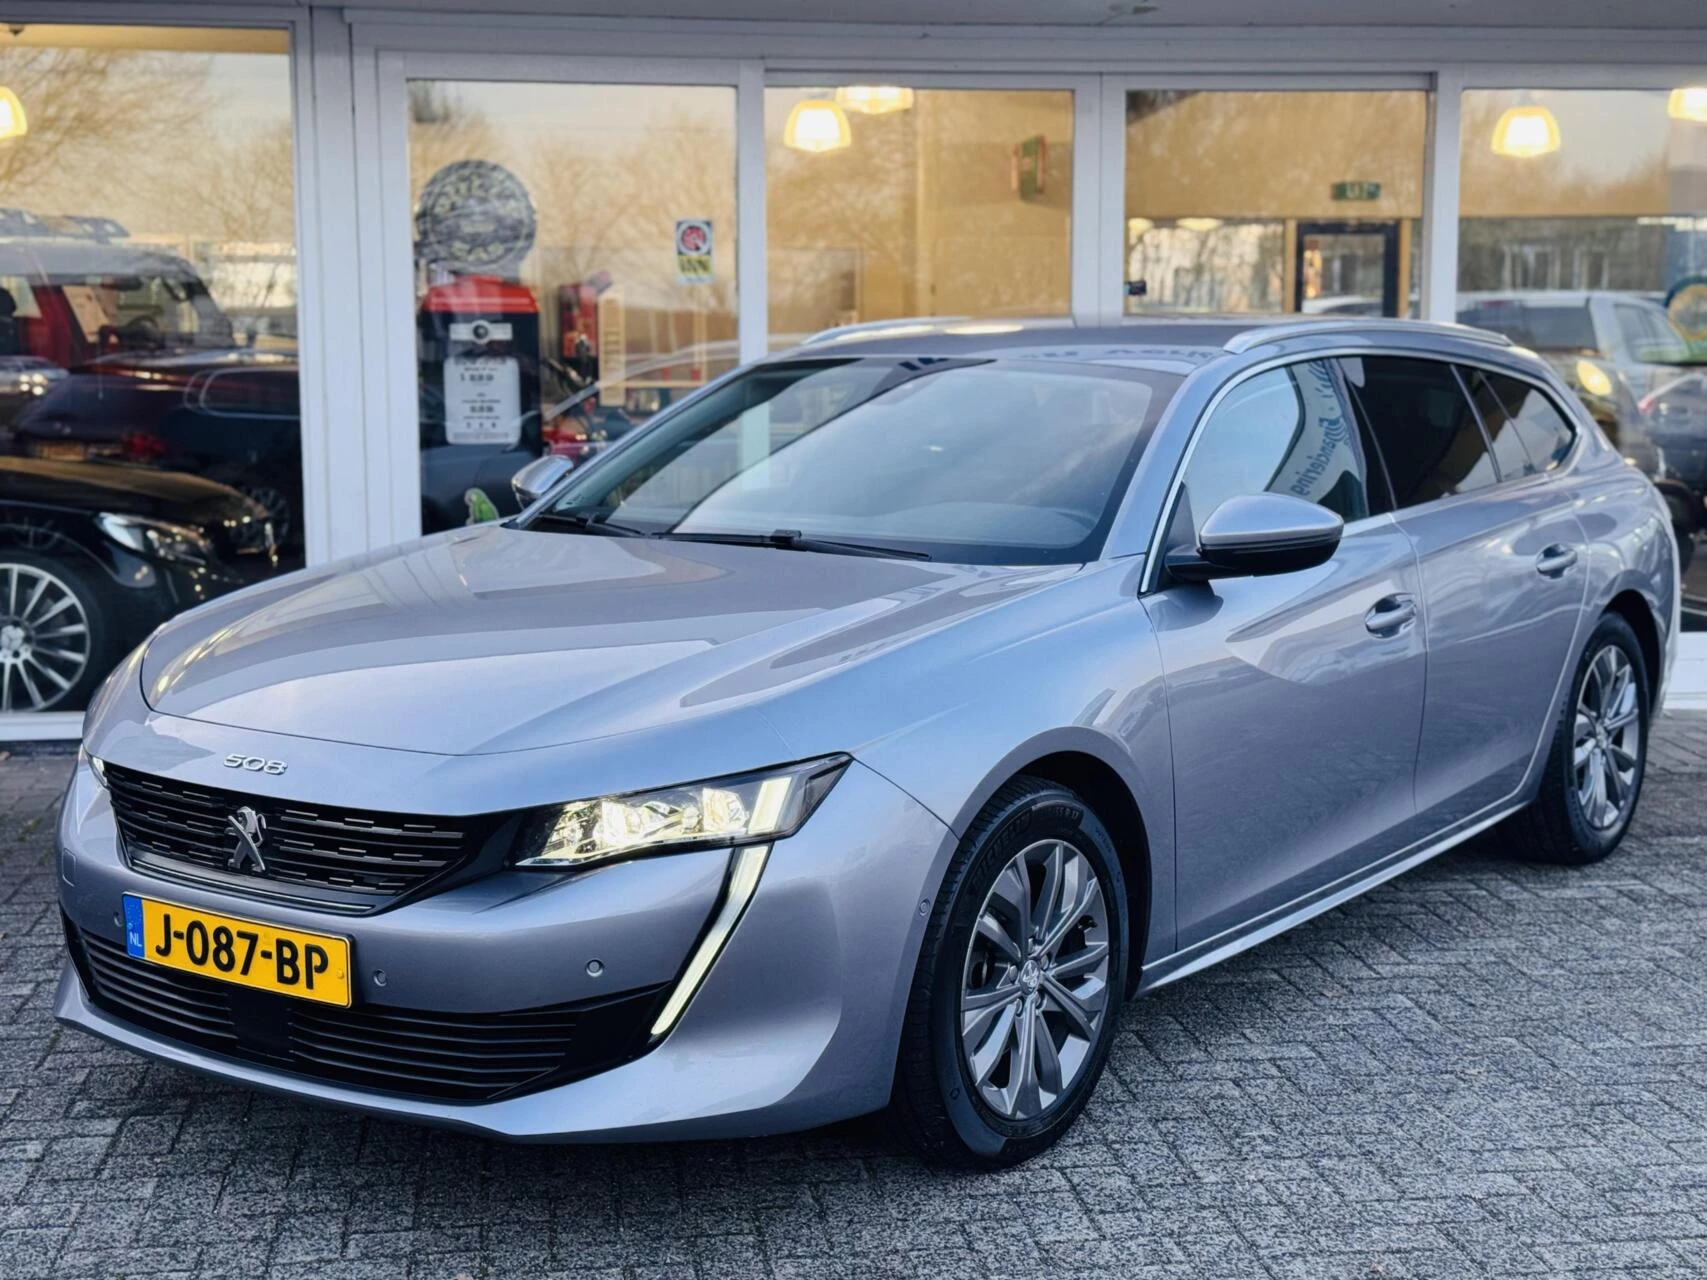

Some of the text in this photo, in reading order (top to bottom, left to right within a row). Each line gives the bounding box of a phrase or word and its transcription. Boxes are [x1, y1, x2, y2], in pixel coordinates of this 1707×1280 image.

[224, 754, 288, 775] 508
[128, 931, 143, 948] NL
[154, 913, 330, 991] J-087-BP
